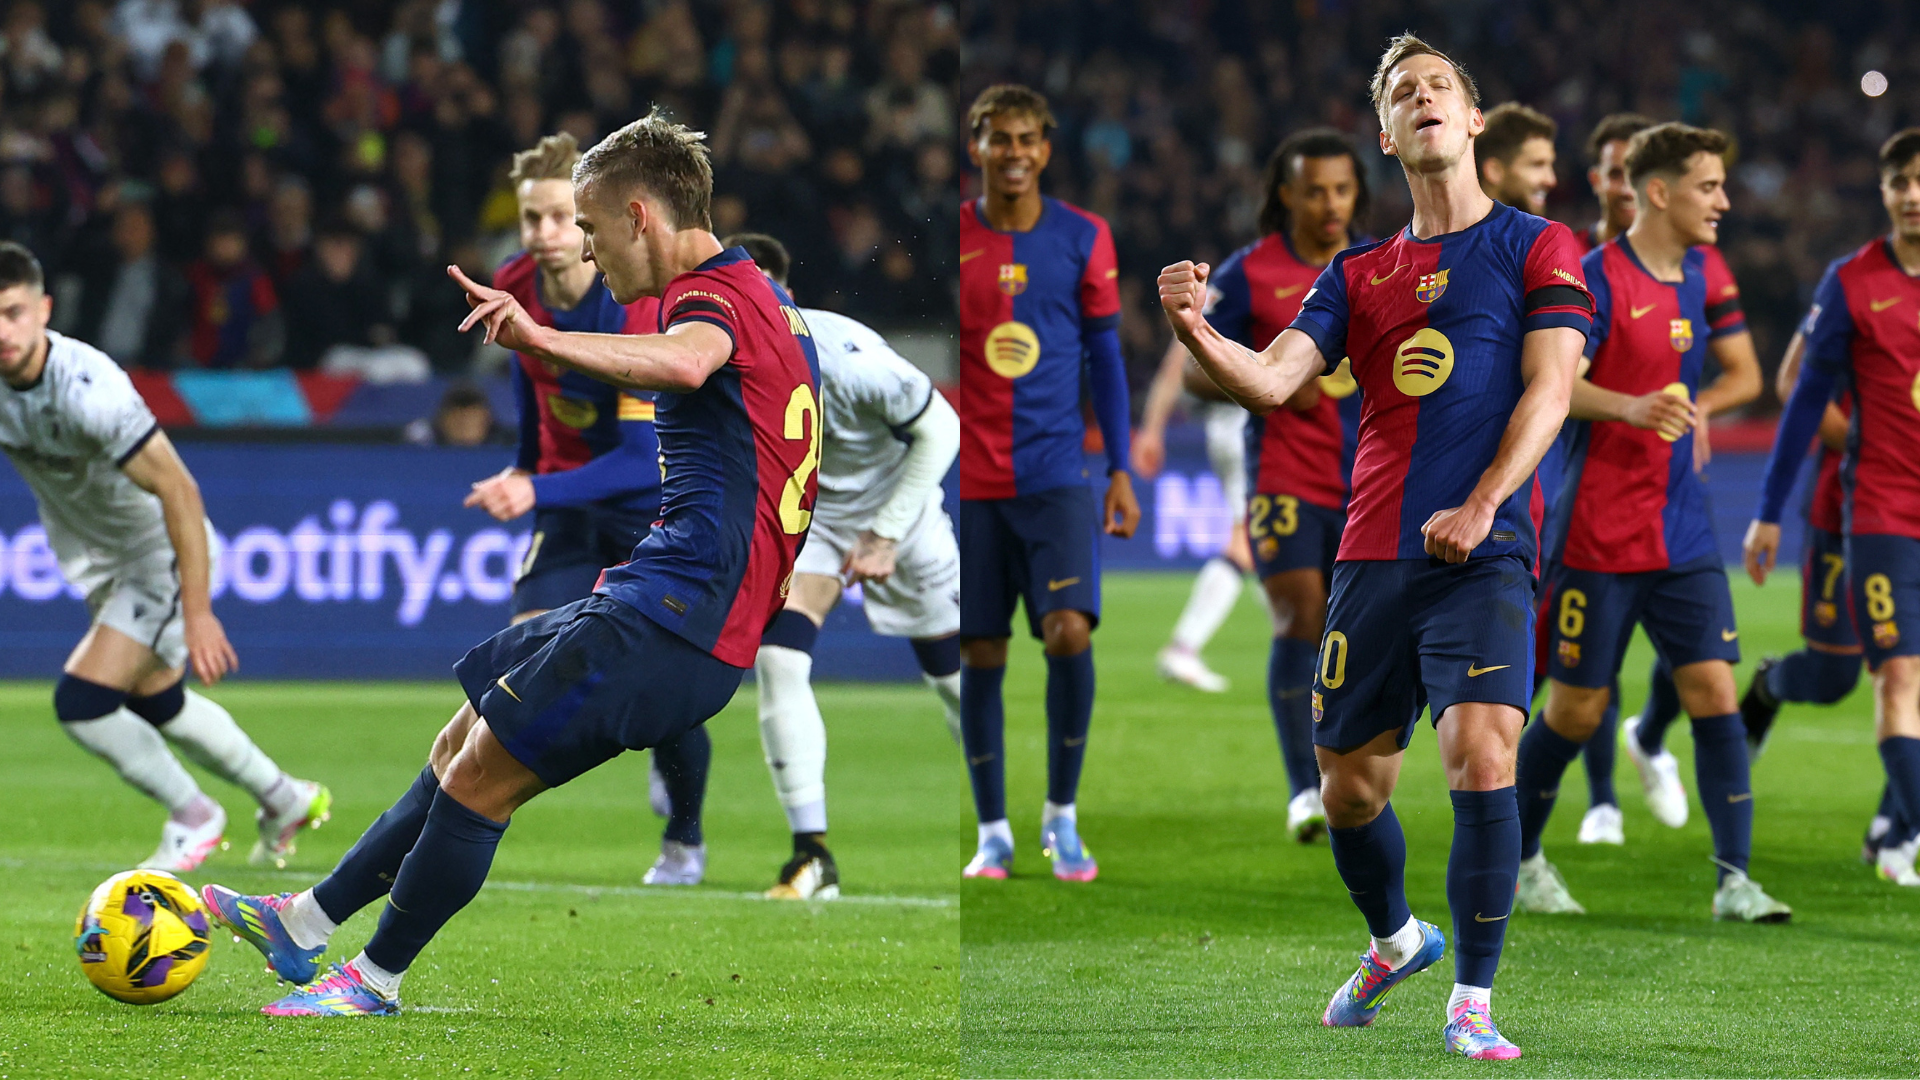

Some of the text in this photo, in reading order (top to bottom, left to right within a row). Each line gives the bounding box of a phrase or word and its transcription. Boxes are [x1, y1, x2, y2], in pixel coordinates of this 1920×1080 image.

[675, 290, 732, 309] AMBILIGHT
[779, 384, 824, 535] 2
[1155, 472, 1232, 558] N
[1249, 494, 1299, 538] 23
[1821, 553, 1844, 600] 7
[1864, 573, 1895, 622] 8
[1558, 588, 1588, 639] 6
[1314, 630, 1348, 690] 0
